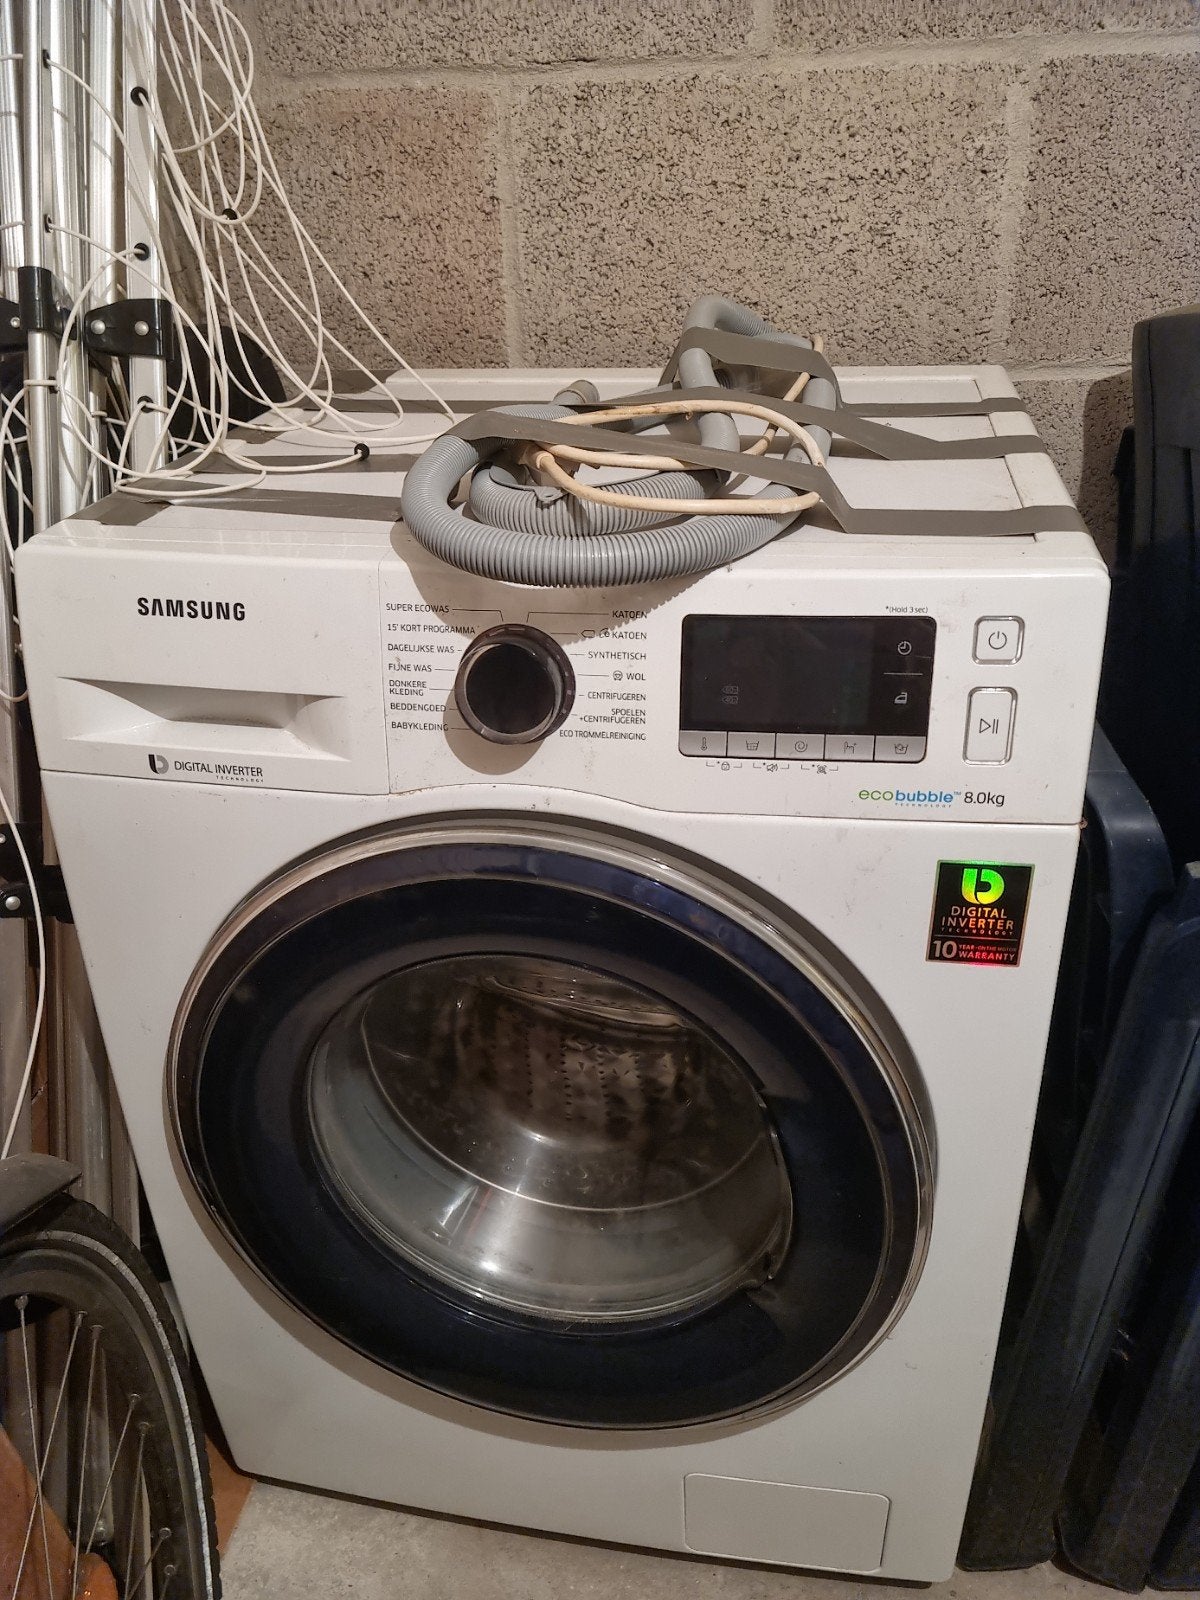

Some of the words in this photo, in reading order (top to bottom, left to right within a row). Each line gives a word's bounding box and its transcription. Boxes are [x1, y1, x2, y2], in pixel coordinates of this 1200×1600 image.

[137, 597, 246, 621] SAMSUNG
[386, 603, 413, 612] SUPER
[414, 604, 450, 613] ECOWAS
[612, 610, 648, 619] KATOEN
[387, 623, 399, 631] 15'
[400, 624, 421, 632] KORT
[423, 625, 476, 635] PROGRAMMA
[612, 631, 648, 640] KATOEN
[387, 643, 435, 653] DAGELIJKSE
[436, 645, 455, 654] WAS
[588, 651, 647, 661] SYNTHETISCH
[388, 663, 411, 672] FIJNE
[413, 664, 432, 672] WAS
[626, 672, 646, 681] WOL
[389, 680, 427, 688] DONKERE
[389, 688, 424, 697] KLEDING
[587, 691, 647, 701] CENTRIFUGEREN
[390, 702, 447, 712] BEDDENGOED
[611, 708, 646, 717] SPOELEN
[579, 715, 646, 725] +CENTRIFUGEREN
[391, 721, 449, 731] BABYKLEDING
[559, 729, 574, 738] ECO
[575, 730, 647, 741] TROMMELREINIGING
[174, 760, 213, 773] DIGITAL
[214, 763, 263, 777] INVERTER
[964, 791, 1005, 808] 8.0kg
[951, 905, 1008, 919] DIGITAL
[941, 916, 1014, 930] INVERTER
[941, 927, 1015, 936] TECHNOLOGY
[933, 940, 958, 959] 10
[958, 950, 1016, 961] WARRANTY
